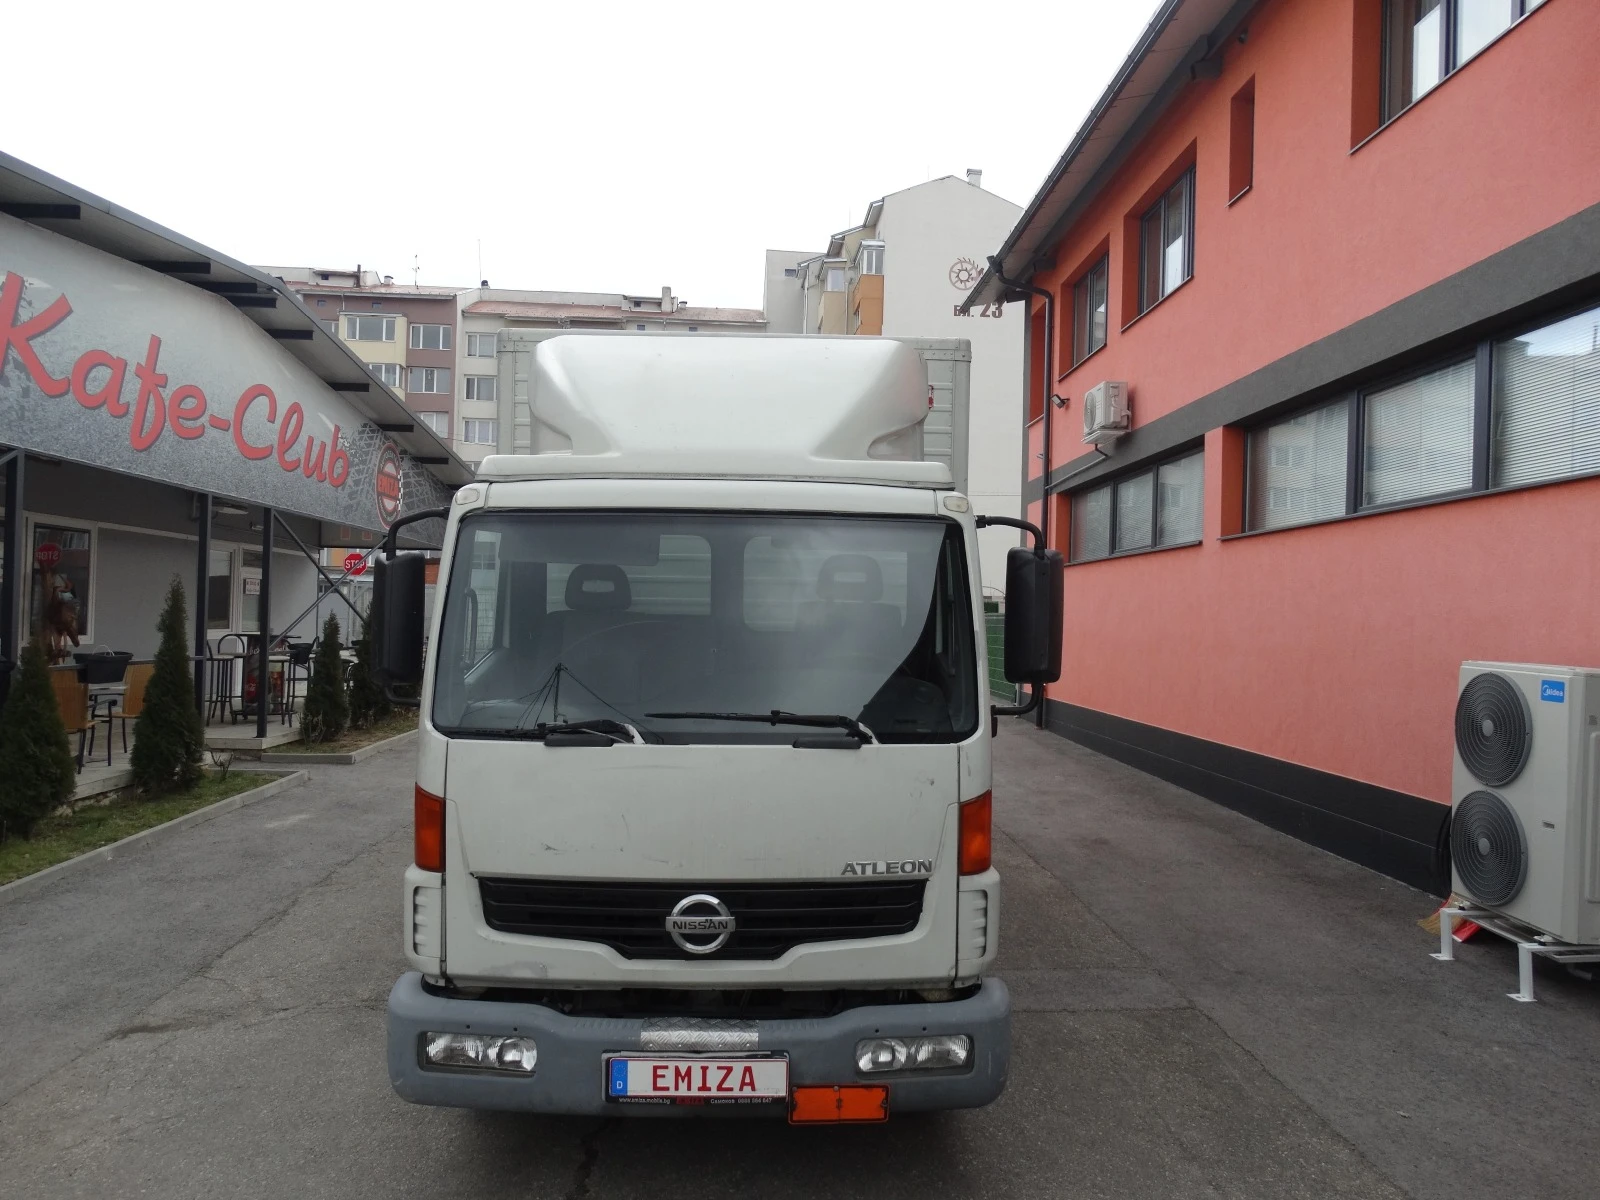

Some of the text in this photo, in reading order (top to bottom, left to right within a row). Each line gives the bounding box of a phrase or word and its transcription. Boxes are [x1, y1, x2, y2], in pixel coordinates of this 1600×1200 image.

[0, 271, 350, 488] Kafe-Club
[1542, 685, 1564, 697] Midea
[841, 859, 933, 875] ATLEON
[673, 920, 728, 930] NISSAN
[616, 1065, 756, 1092] D EMIZA
